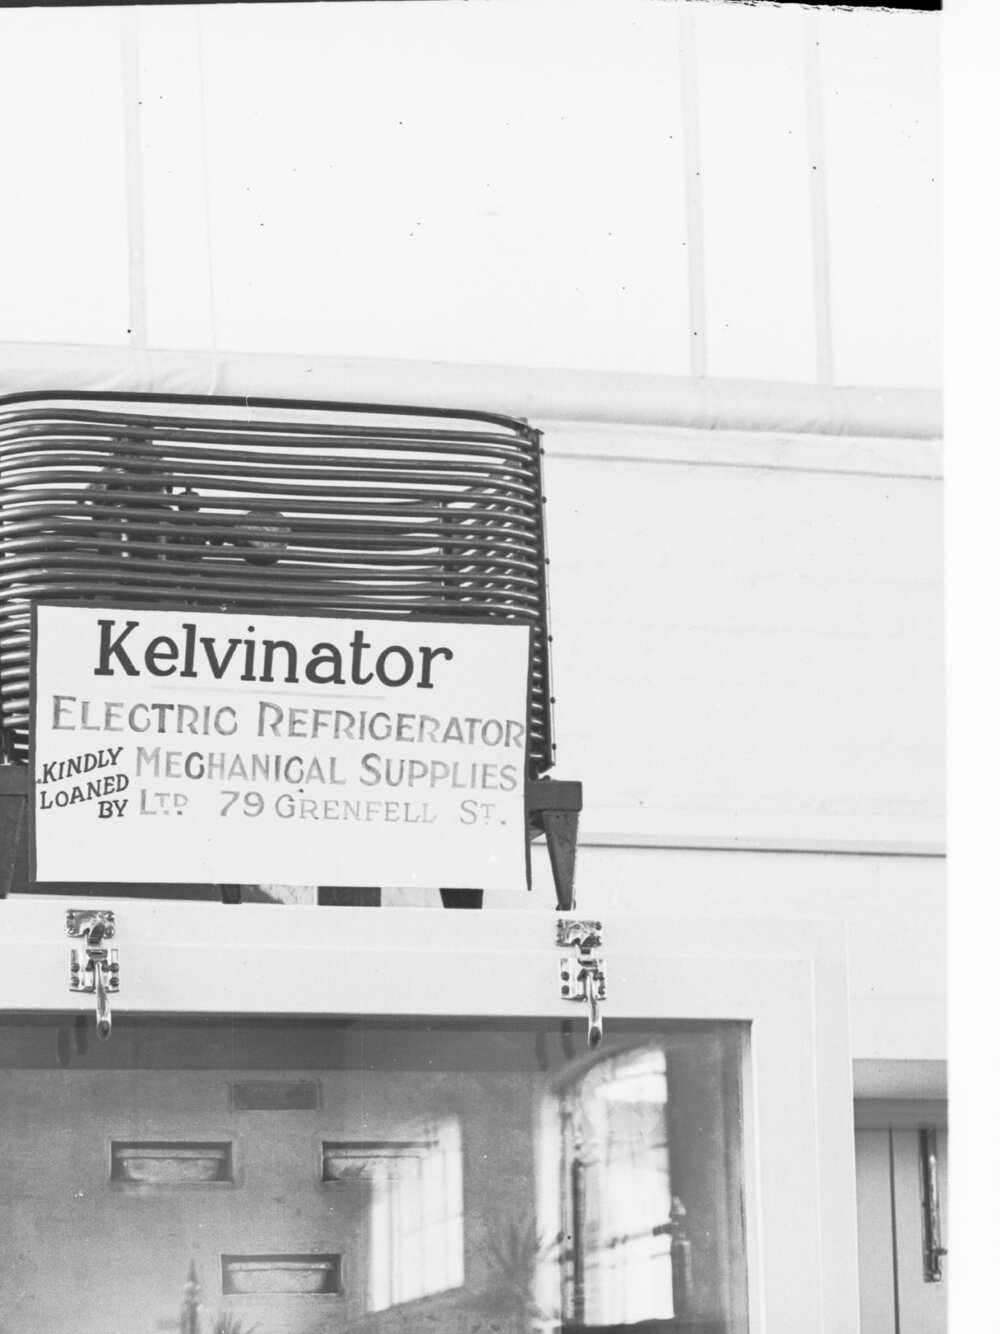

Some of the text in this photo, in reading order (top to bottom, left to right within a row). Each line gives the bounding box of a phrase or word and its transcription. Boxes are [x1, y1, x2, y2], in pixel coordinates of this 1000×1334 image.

[94, 619, 454, 688] Kelvinator
[52, 695, 525, 748] ELECTRIC REFRIGERATOR
[42, 747, 124, 785] KINDLY
[136, 746, 519, 792] MECHANICAL SUPPLIES
[40, 774, 130, 810] LOANED
[98, 799, 129, 819] BY
[218, 790, 266, 818] 79
[275, 794, 438, 824] GRENFELL
